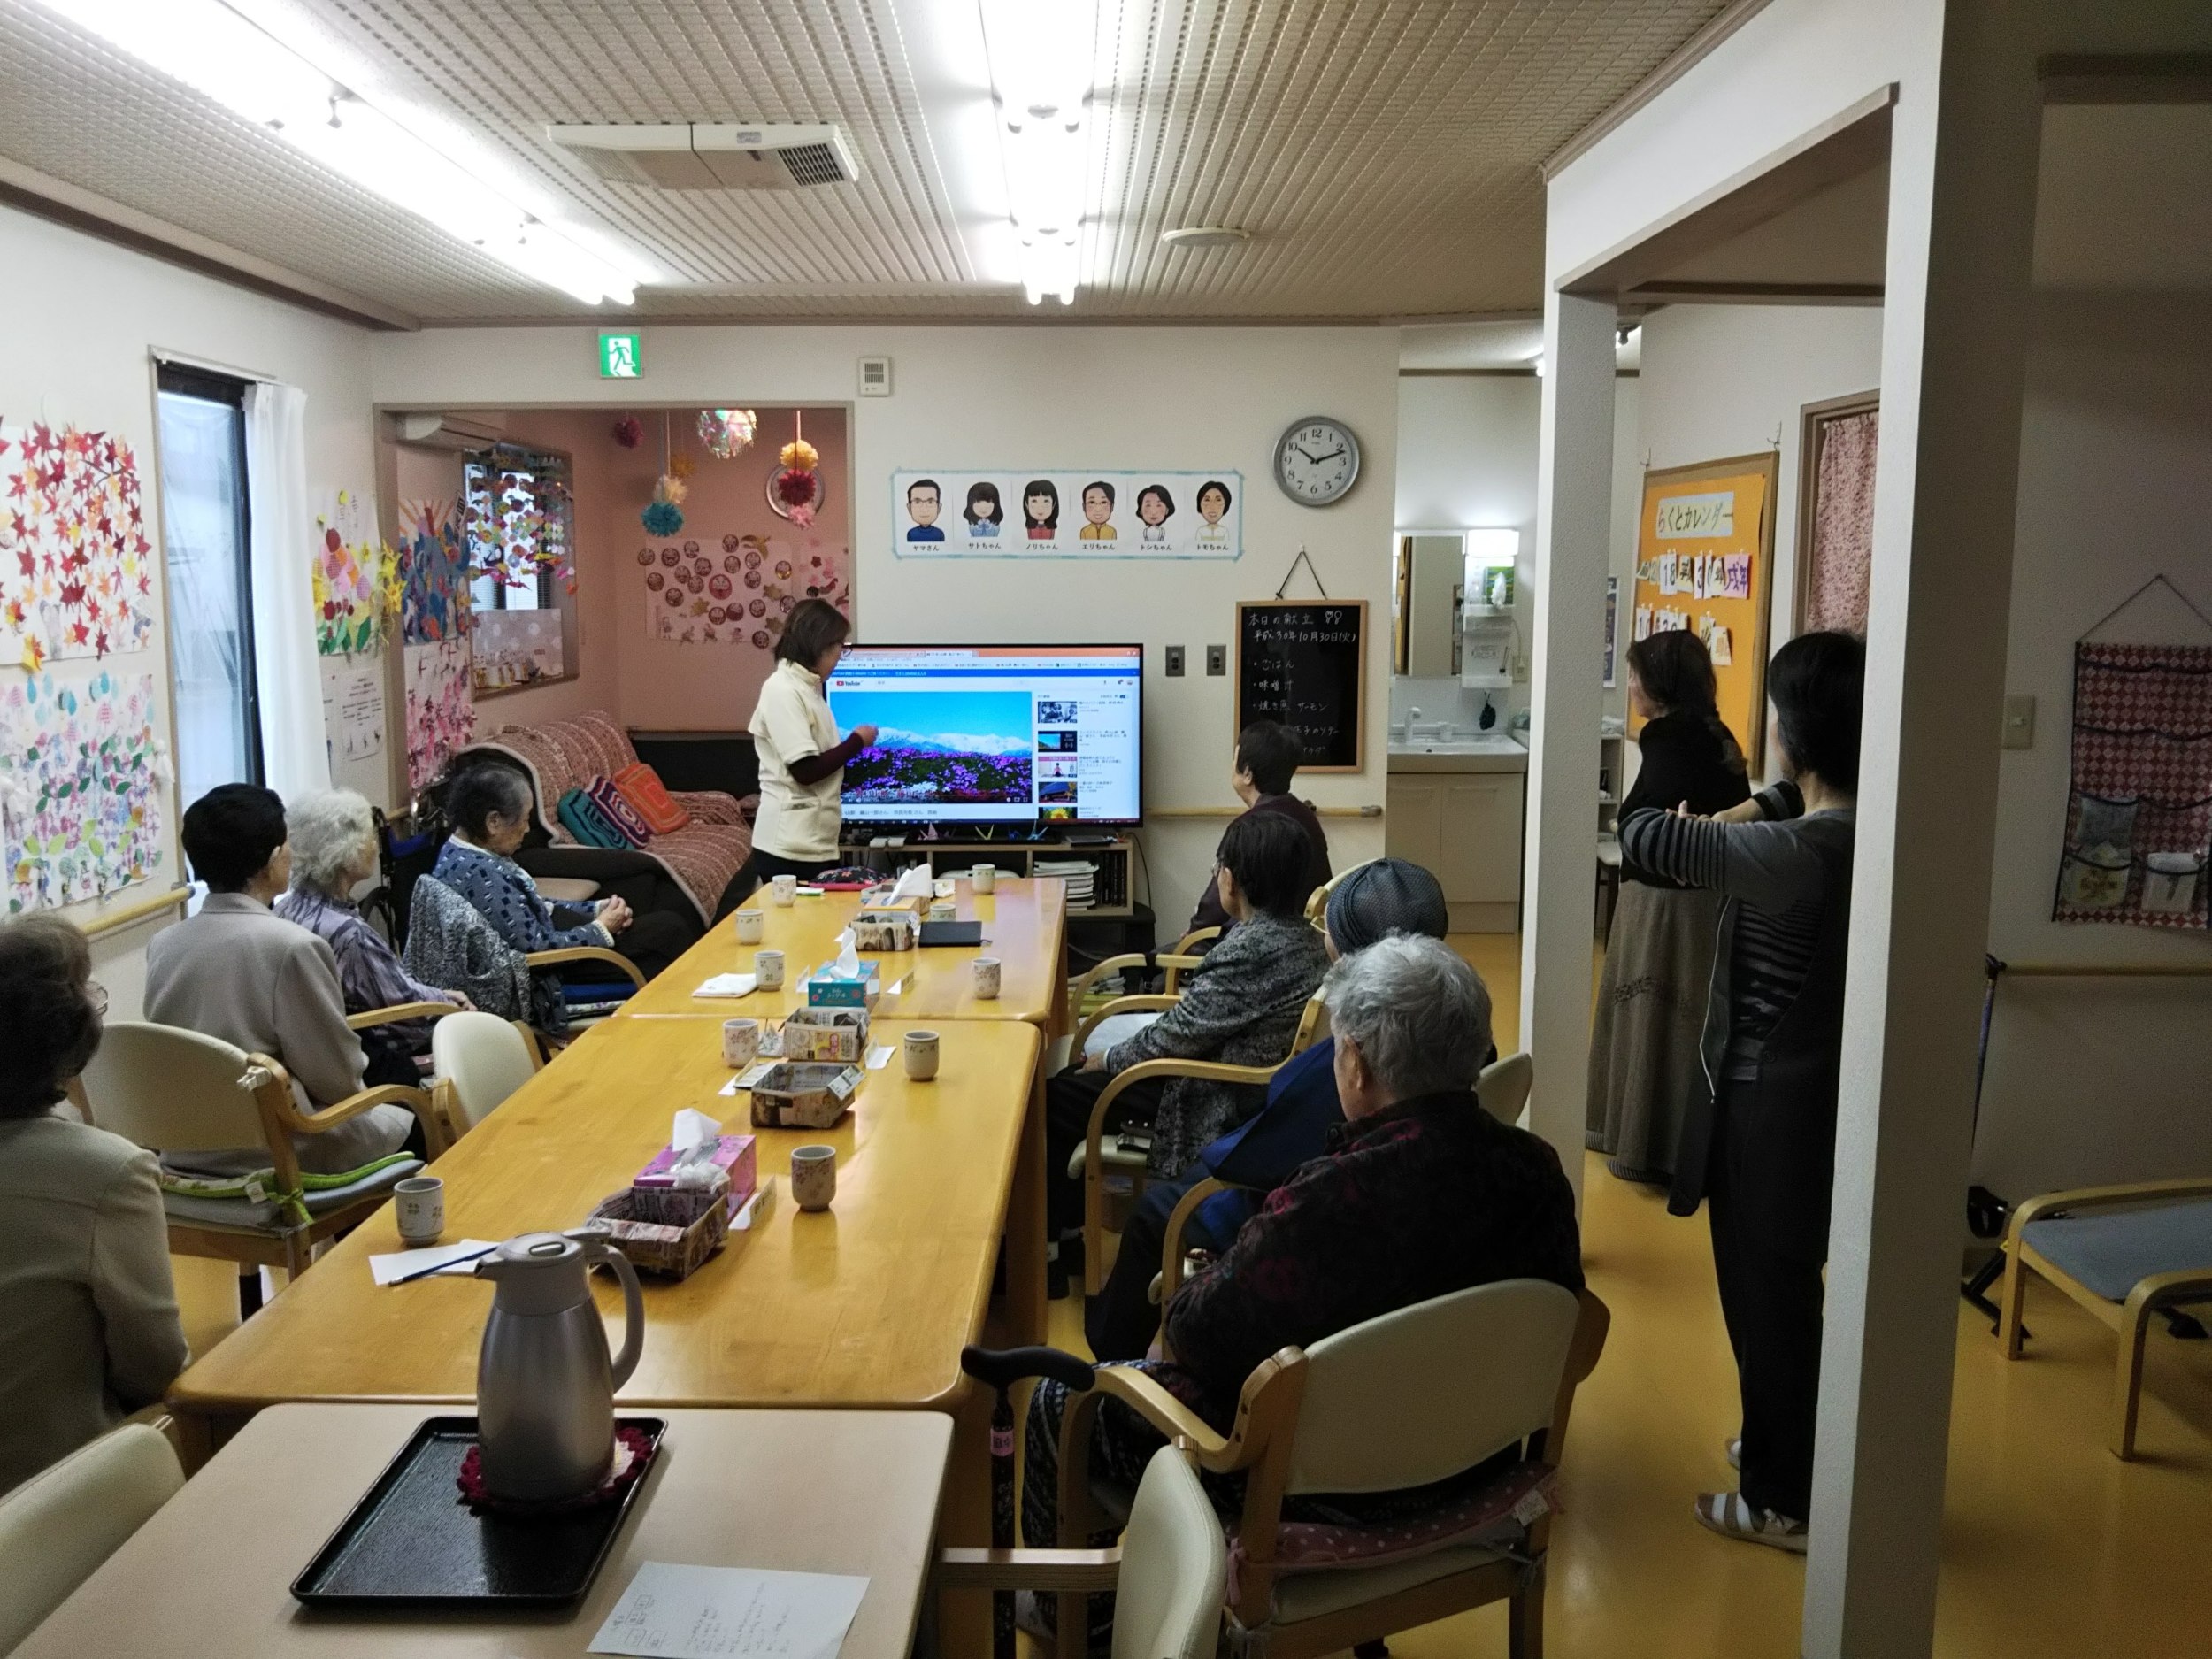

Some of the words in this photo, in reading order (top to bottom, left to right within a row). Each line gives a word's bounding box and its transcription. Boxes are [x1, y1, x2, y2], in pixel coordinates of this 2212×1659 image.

[1300, 432, 1307, 442] 11
[1312, 428, 1323, 438] 12
[1329, 432, 1333, 442] 1
[1288, 442, 1298, 451] 10
[1285, 456, 1292, 465] 9
[1339, 457, 1346, 466] 3
[1287, 470, 1295, 480] 8
[1334, 471, 1342, 480] 4
[1297, 480, 1304, 490] 7
[1310, 485, 1317, 494] 6
[1325, 480, 1332, 490] 5
[1025, 542, 1059, 551] ノリちゃん
[1248, 612, 1314, 626] 本日の献立
